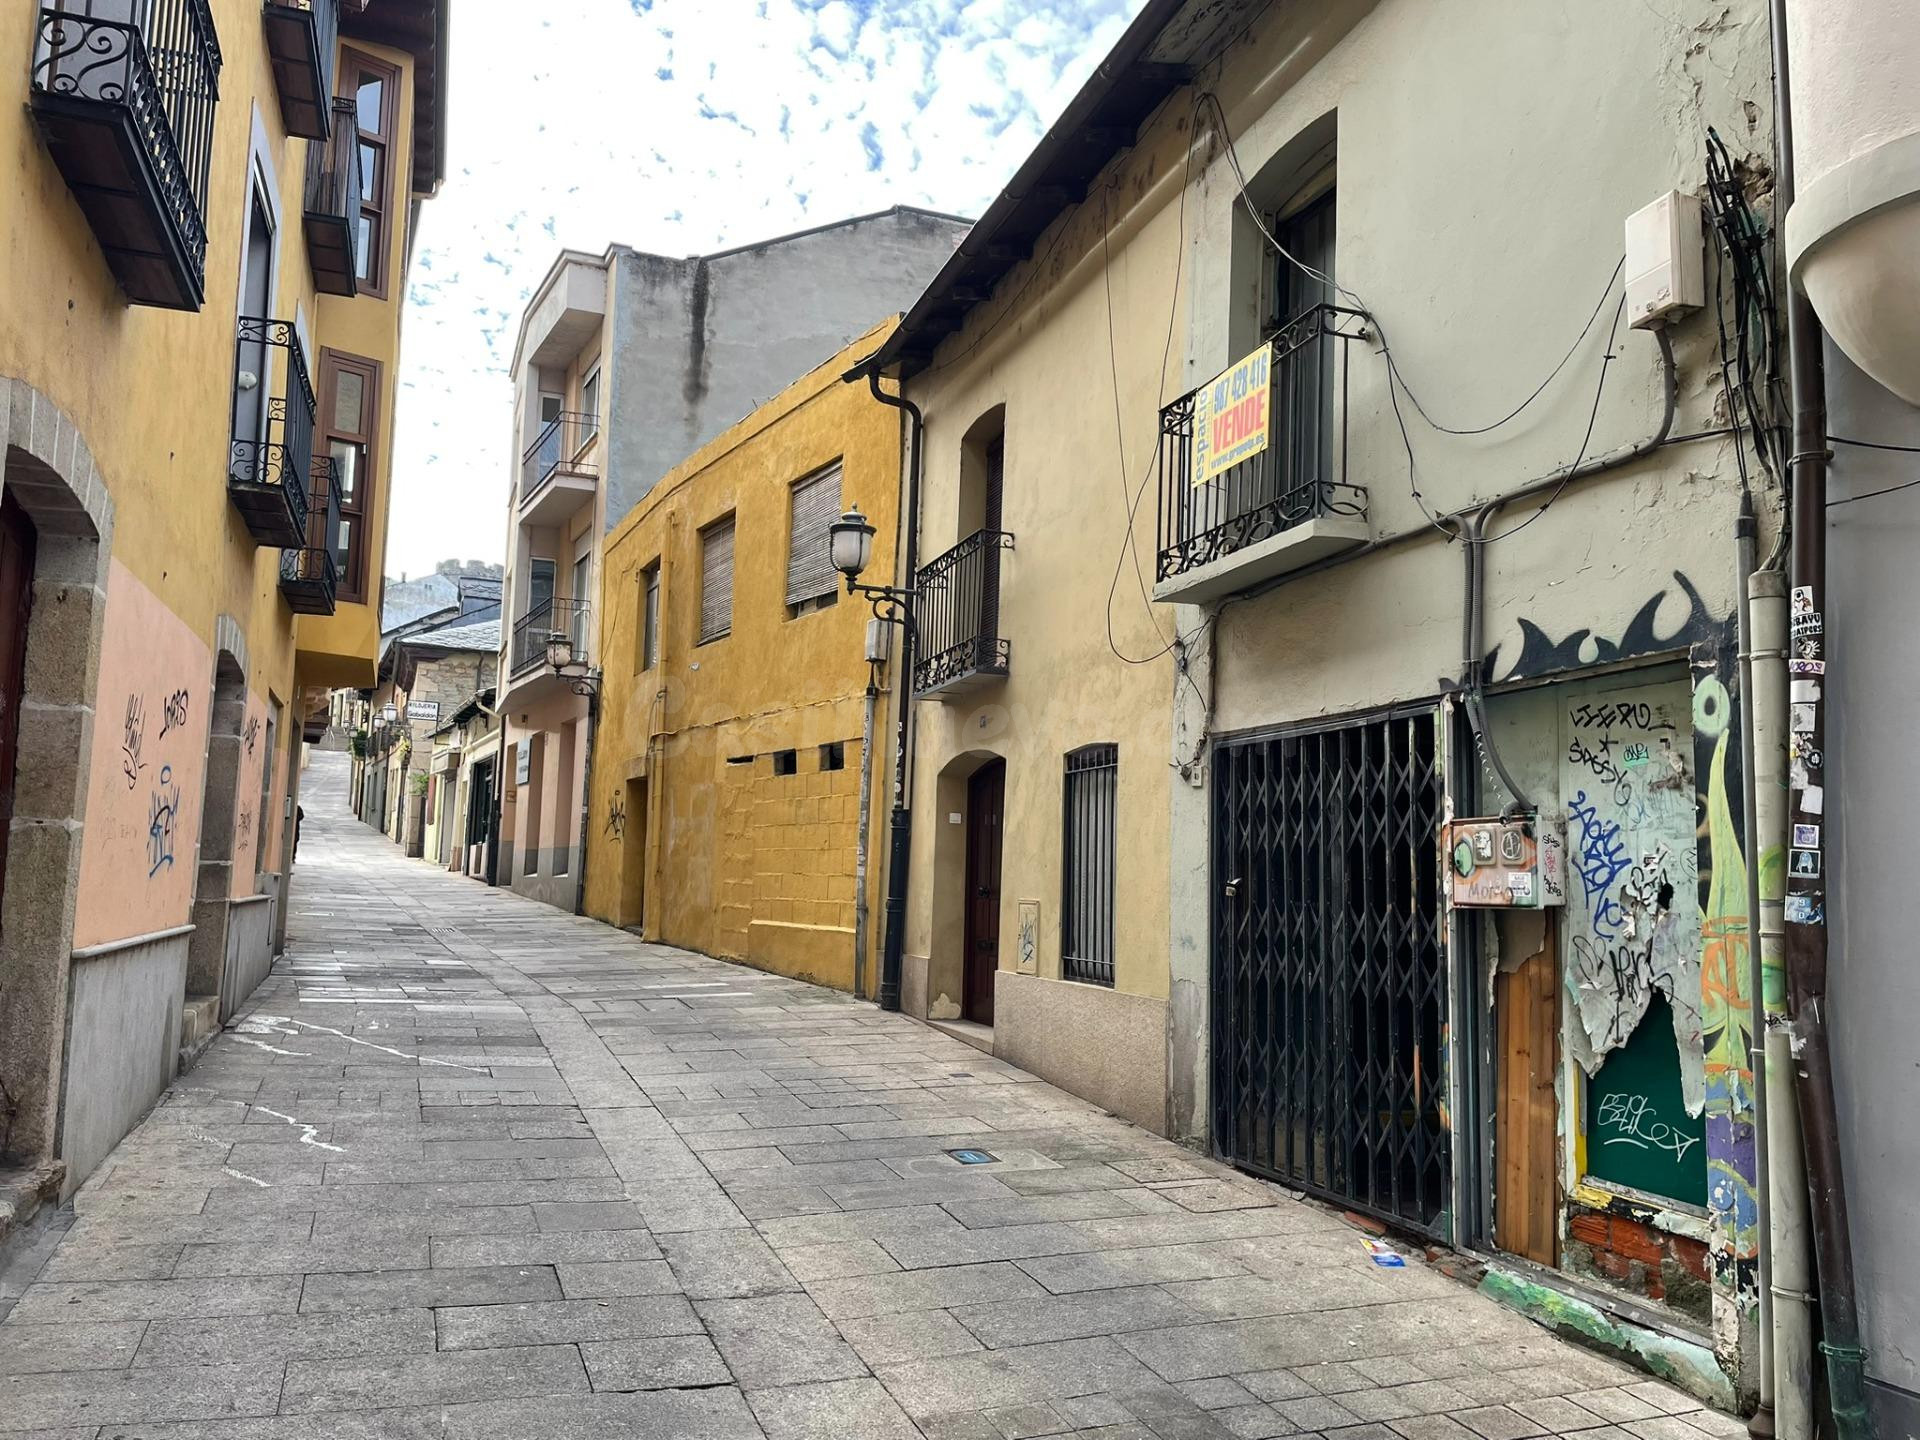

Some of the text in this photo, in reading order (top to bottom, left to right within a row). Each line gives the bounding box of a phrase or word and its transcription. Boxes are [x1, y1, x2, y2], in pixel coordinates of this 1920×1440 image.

[1213, 352, 1267, 414] 987 428 416
[1196, 391, 1209, 480] espacio
[1213, 389, 1265, 454] VENDE
